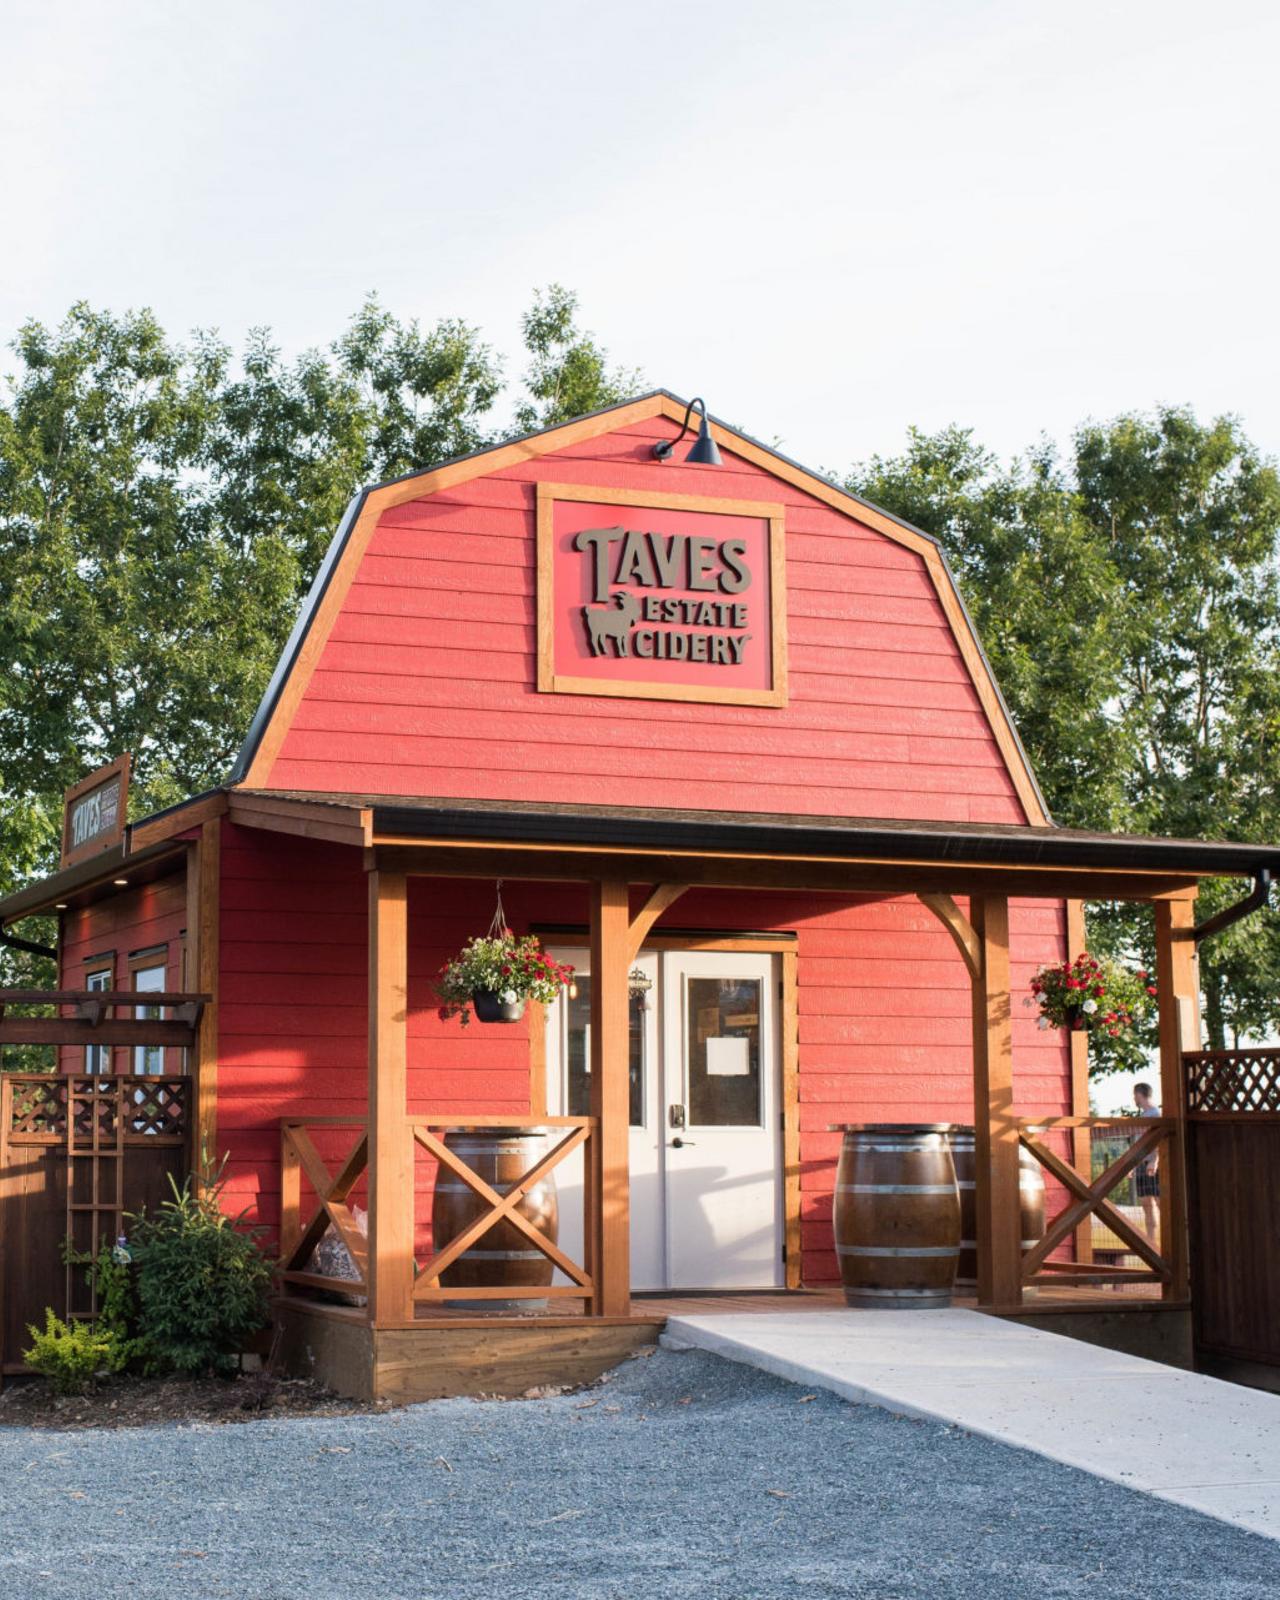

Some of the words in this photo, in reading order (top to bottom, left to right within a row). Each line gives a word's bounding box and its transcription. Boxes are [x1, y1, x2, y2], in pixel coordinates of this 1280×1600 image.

[573, 526, 752, 602] TAVES
[643, 596, 748, 628] ESTATE
[634, 629, 752, 665] CIDERY
